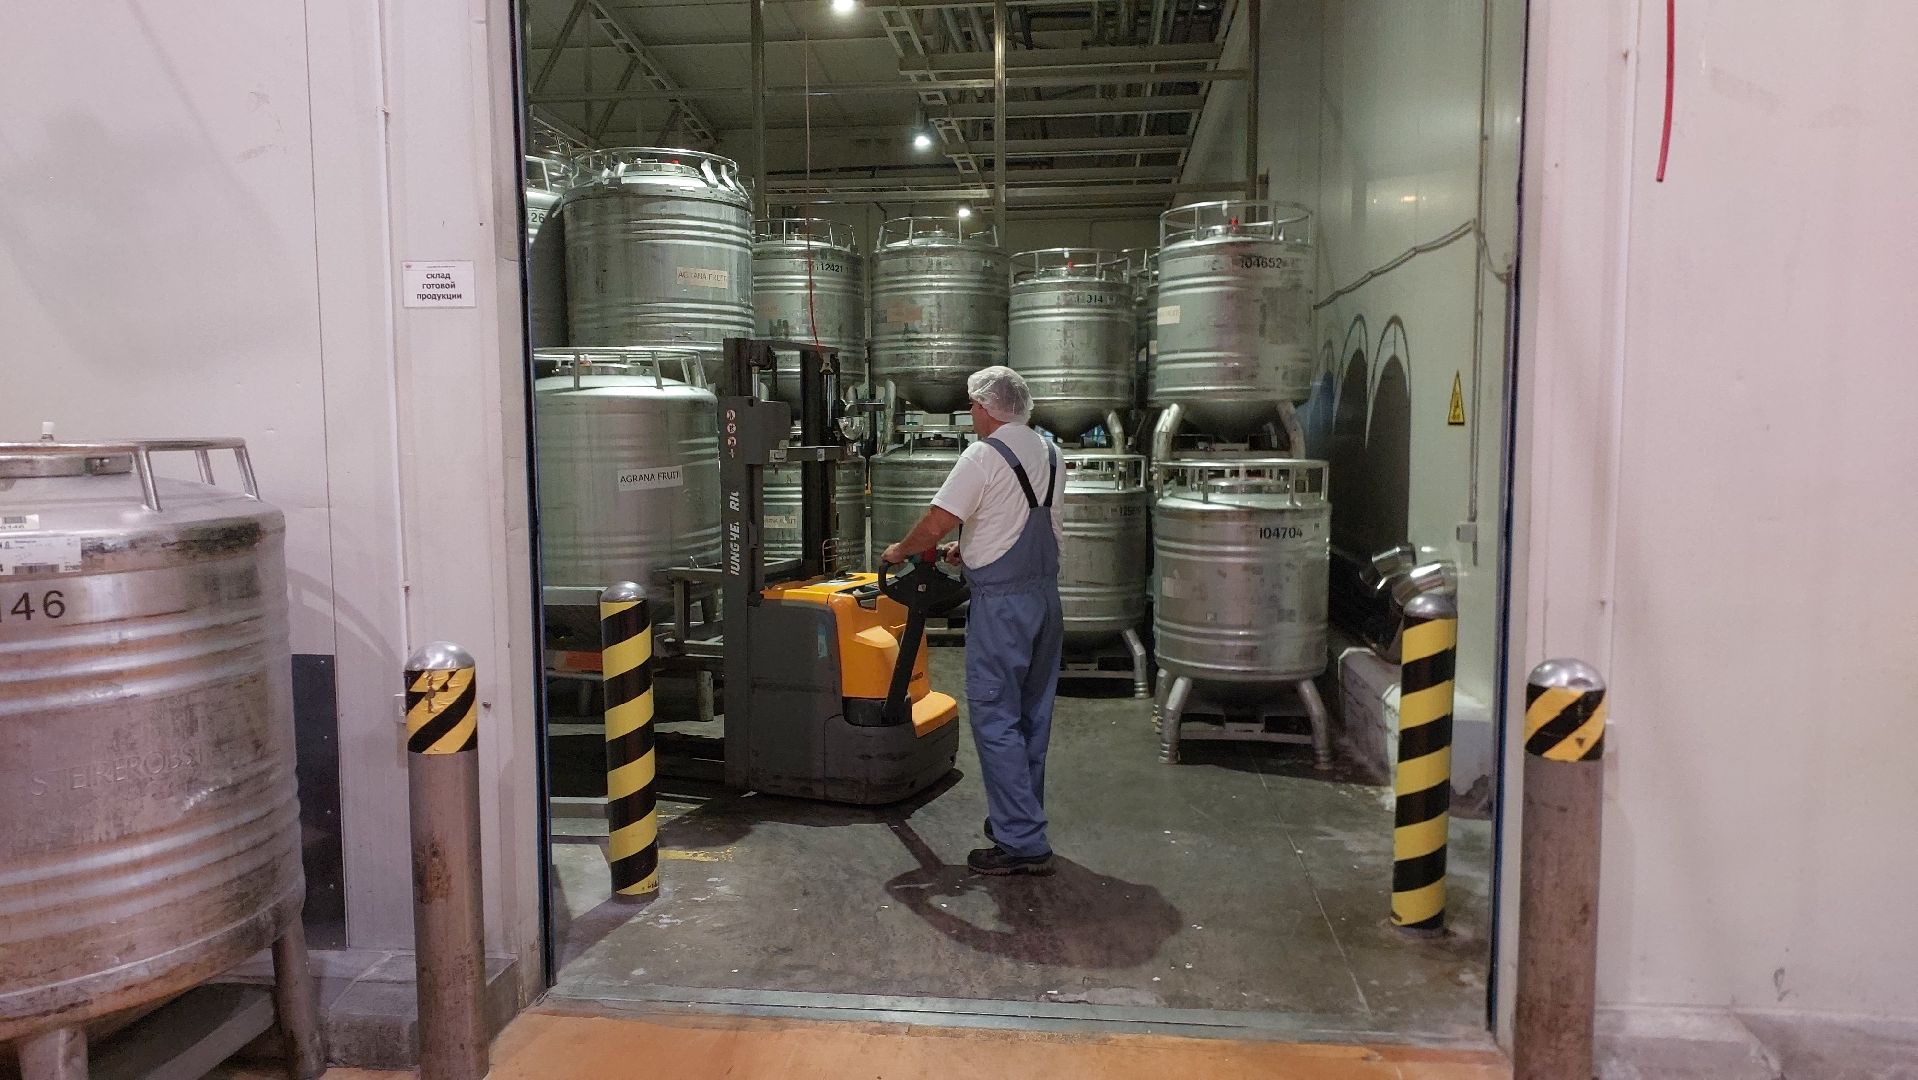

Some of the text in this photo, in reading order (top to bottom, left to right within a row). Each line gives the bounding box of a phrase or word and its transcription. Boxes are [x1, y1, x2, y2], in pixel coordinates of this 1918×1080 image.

[422, 281, 456, 289] готовой
[416, 293, 462, 301] продукции
[620, 473, 656, 483] AGRANA
[1259, 527, 1303, 539] 104704
